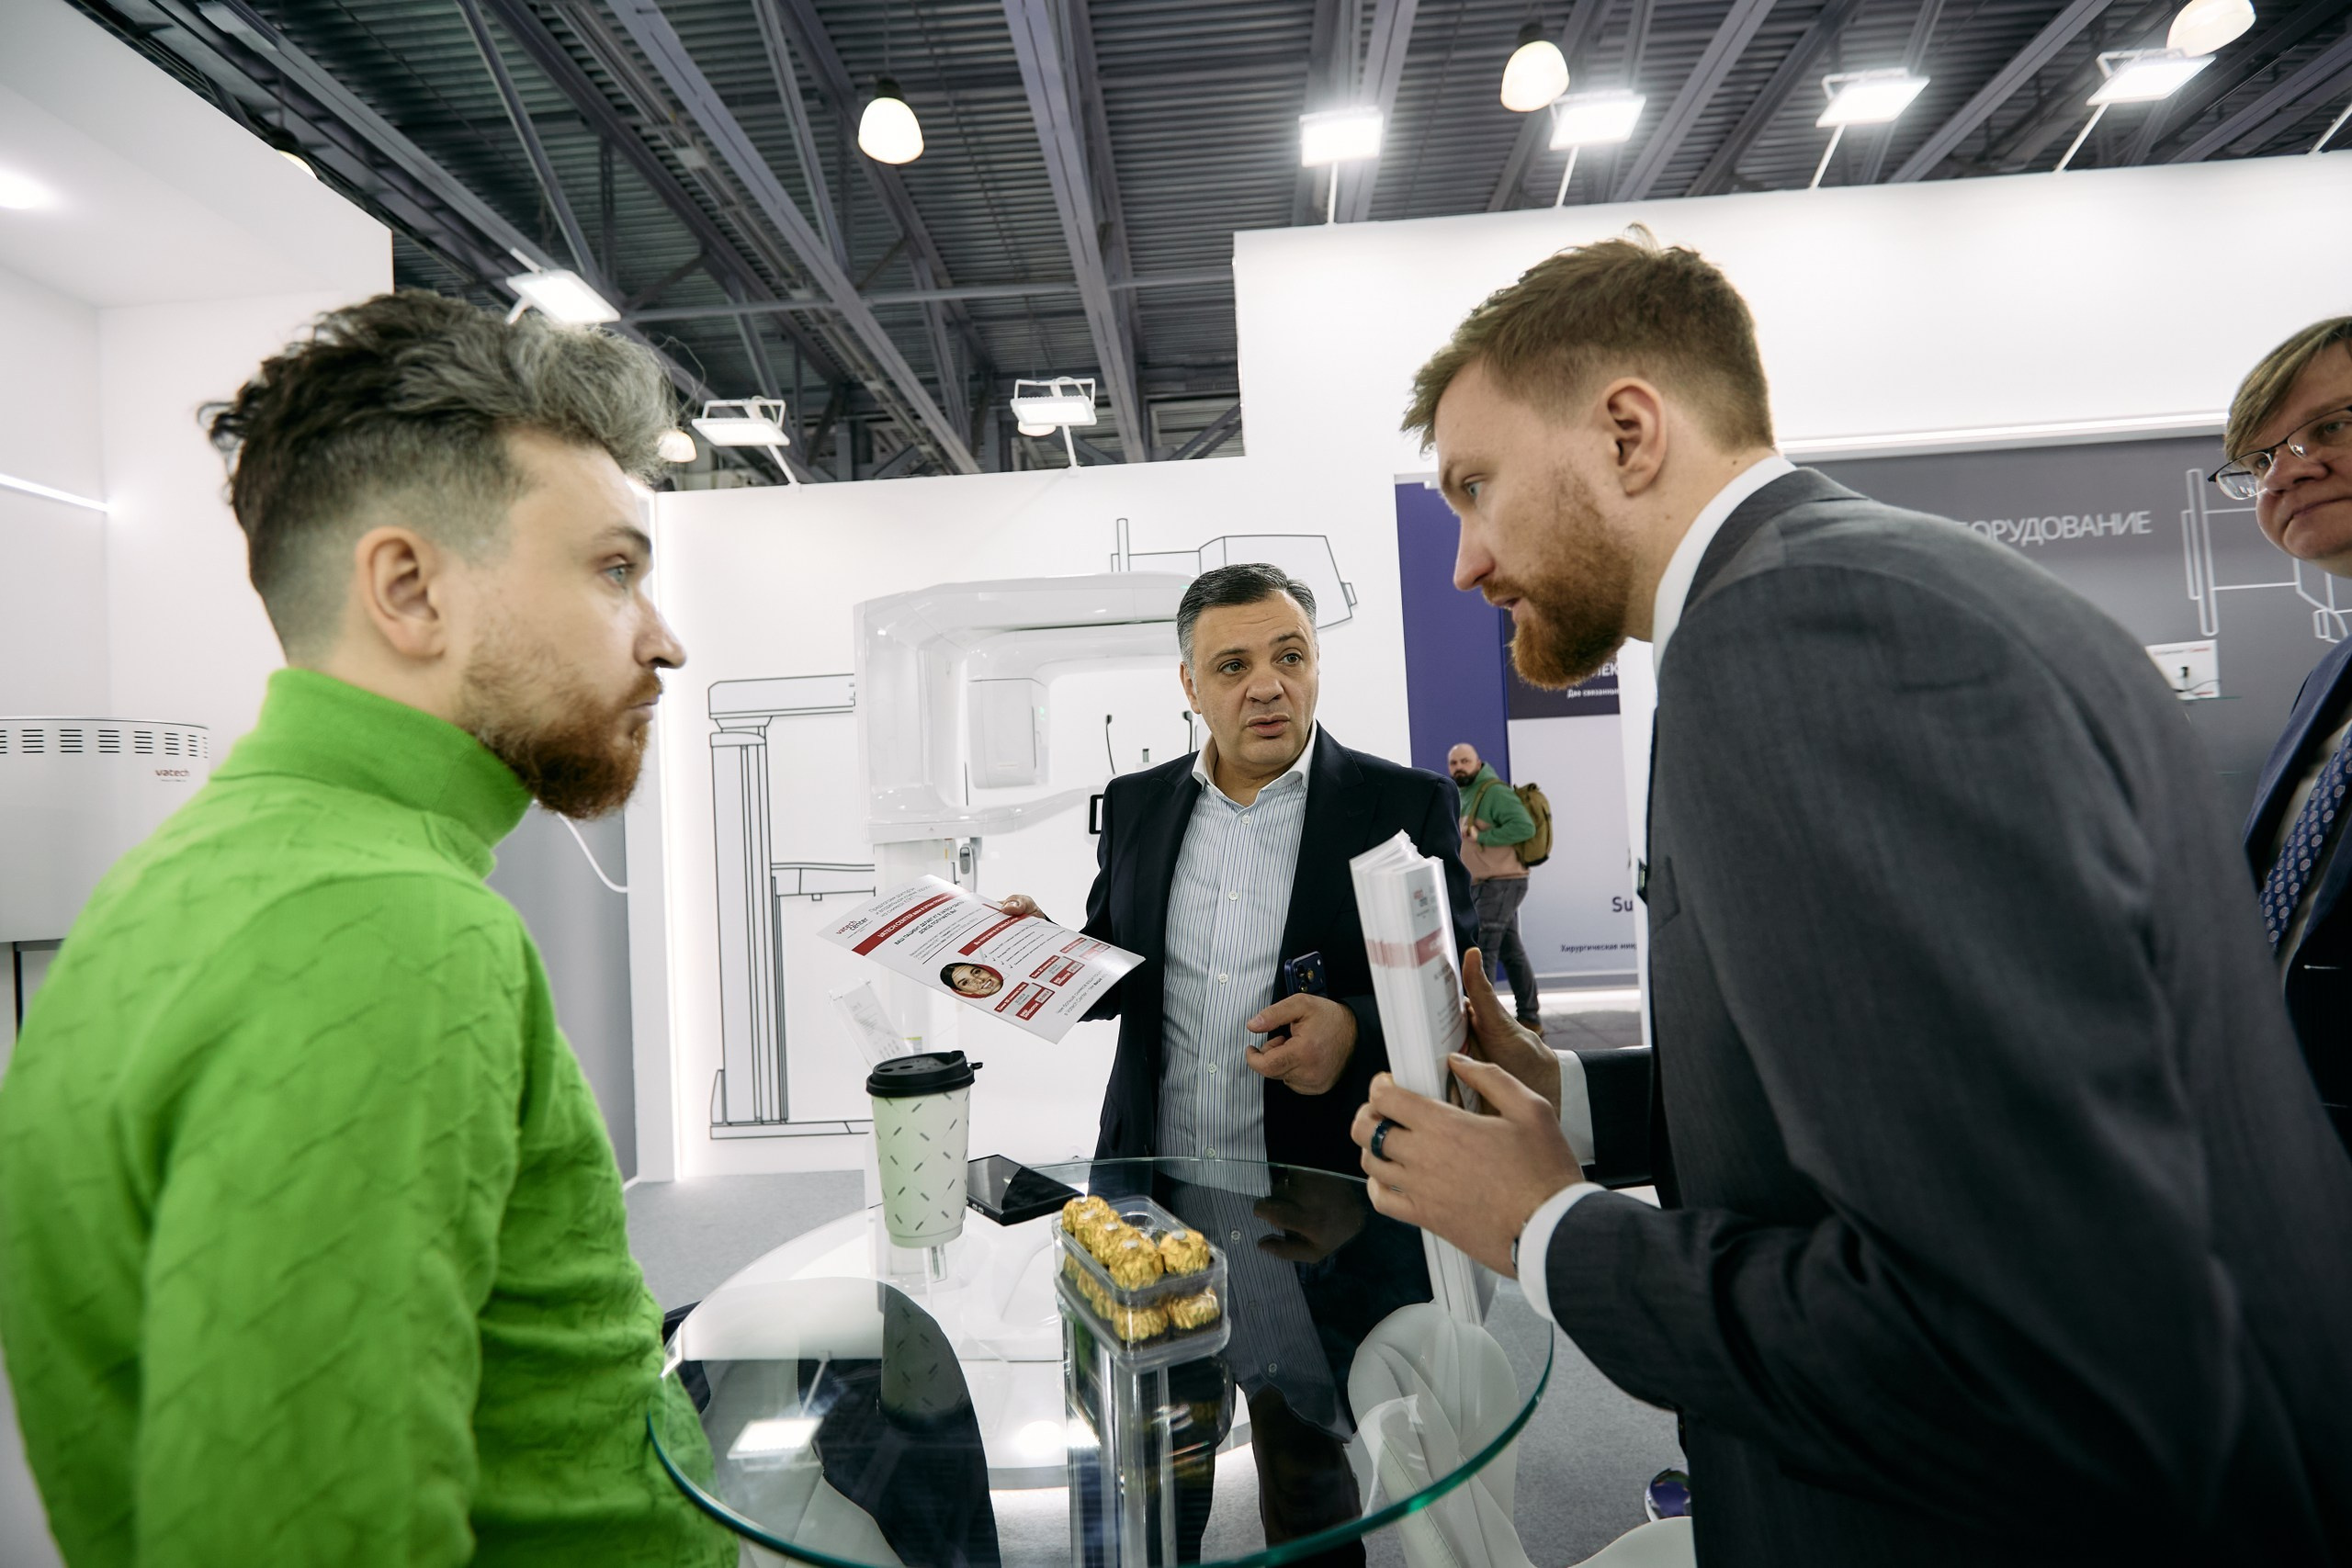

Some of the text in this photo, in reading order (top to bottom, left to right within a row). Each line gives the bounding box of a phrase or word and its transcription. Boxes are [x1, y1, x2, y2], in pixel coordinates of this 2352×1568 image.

[1955, 510, 2154, 547] ОРУДОВАНИЕ
[155, 769, 190, 777] vatech
[1611, 896, 1633, 913] Su
[836, 919, 858, 935] vatech
[849, 918, 870, 931] center
[877, 924, 899, 938] VATECH
[894, 913, 915, 926] CENTER
[1561, 942, 1618, 954] Хирургическая
